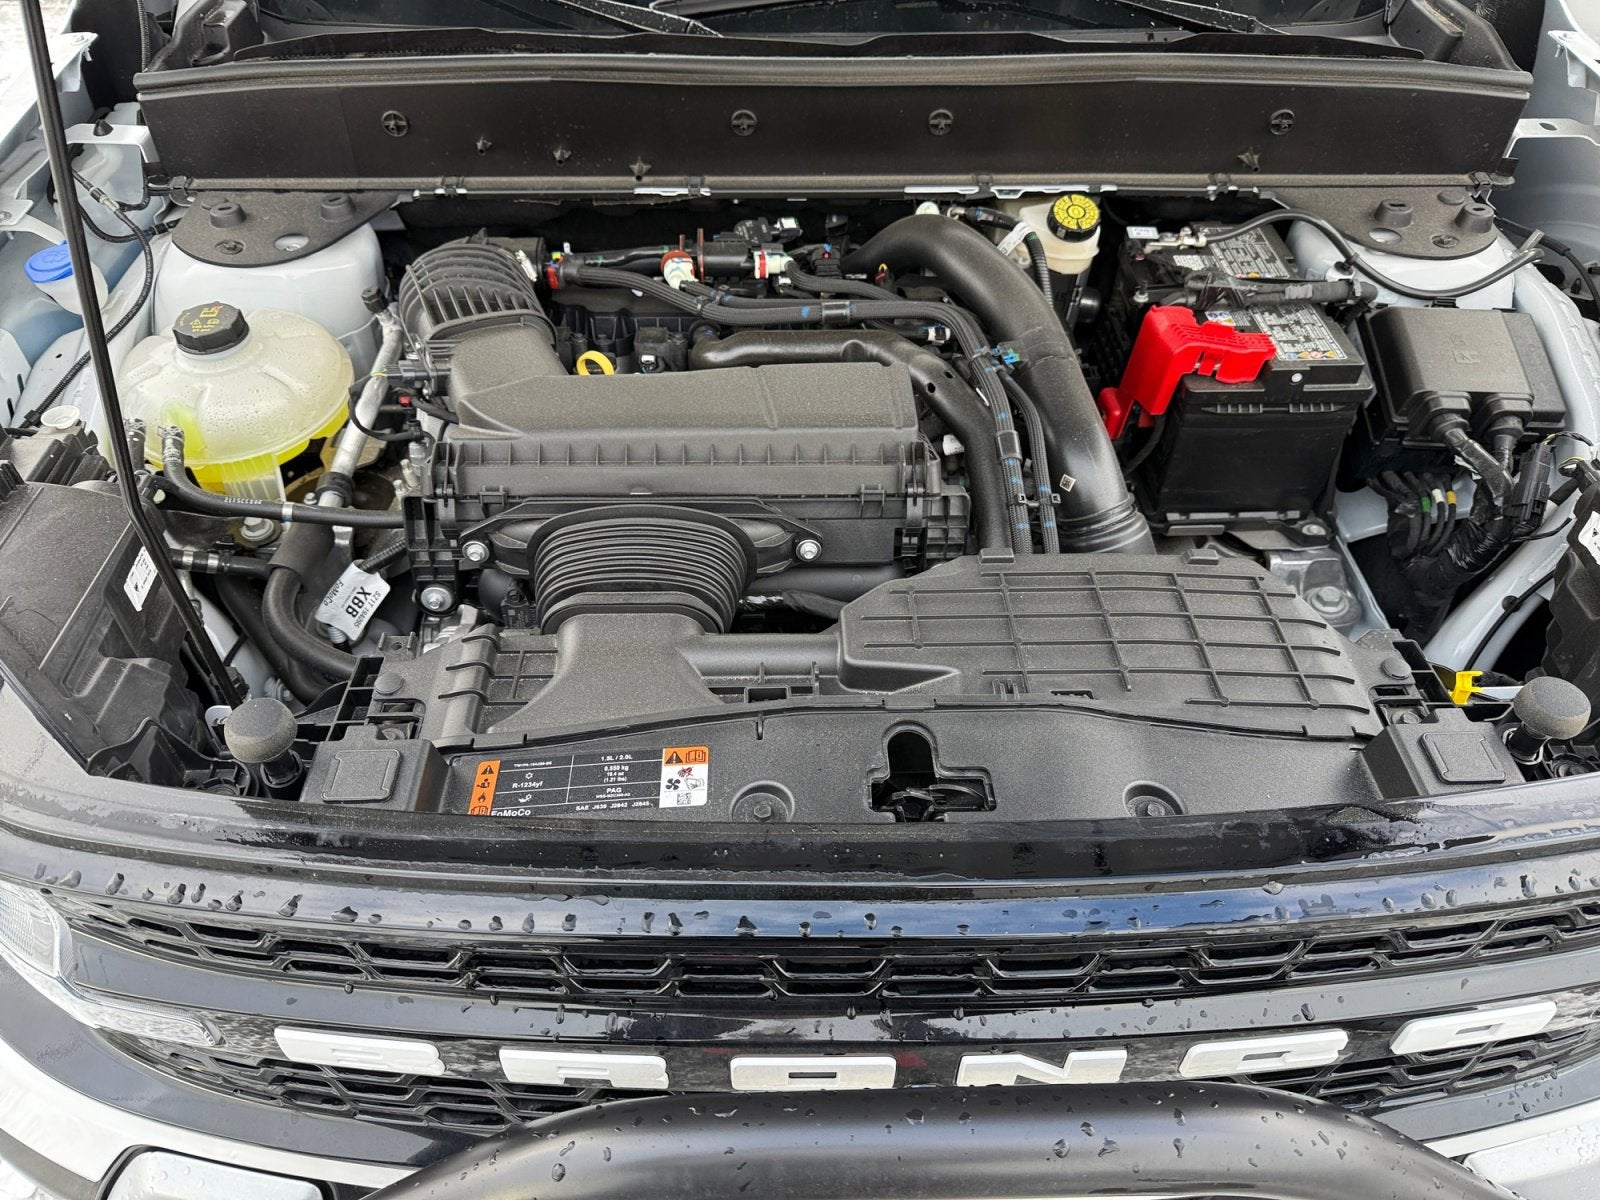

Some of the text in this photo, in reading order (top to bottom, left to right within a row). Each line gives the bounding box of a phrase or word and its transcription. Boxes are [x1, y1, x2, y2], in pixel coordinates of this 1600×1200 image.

[323, 580, 344, 607] FoMoCo
[345, 586, 372, 618] XBB
[512, 781, 543, 789] R-1234yf
[273, 1000, 1558, 1092] BRONCO
